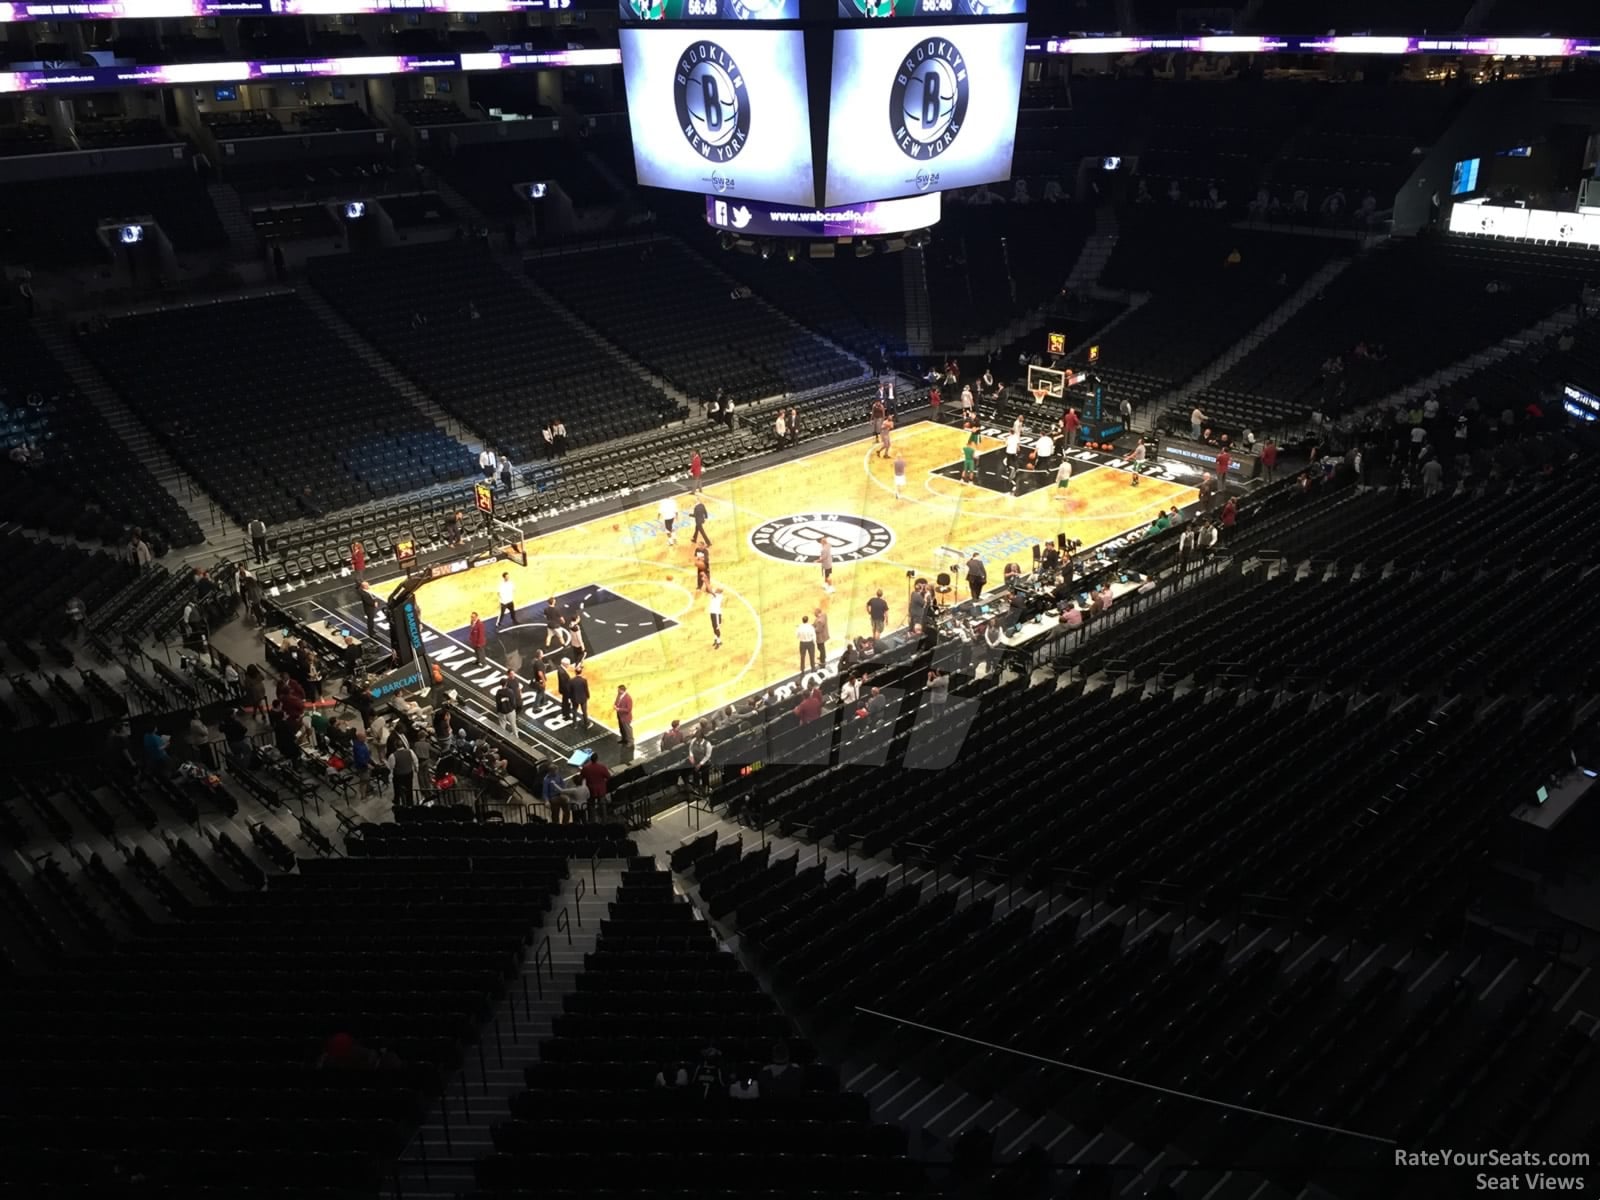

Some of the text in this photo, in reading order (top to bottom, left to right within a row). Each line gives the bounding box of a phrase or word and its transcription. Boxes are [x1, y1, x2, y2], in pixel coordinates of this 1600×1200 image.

[677, 45, 744, 88] BROOKLYN
[898, 41, 967, 86] BROOKLYN
[685, 124, 746, 160] NEW YORK
[896, 120, 960, 157] NEW YORK
[794, 527, 889, 562] BROOKLN
